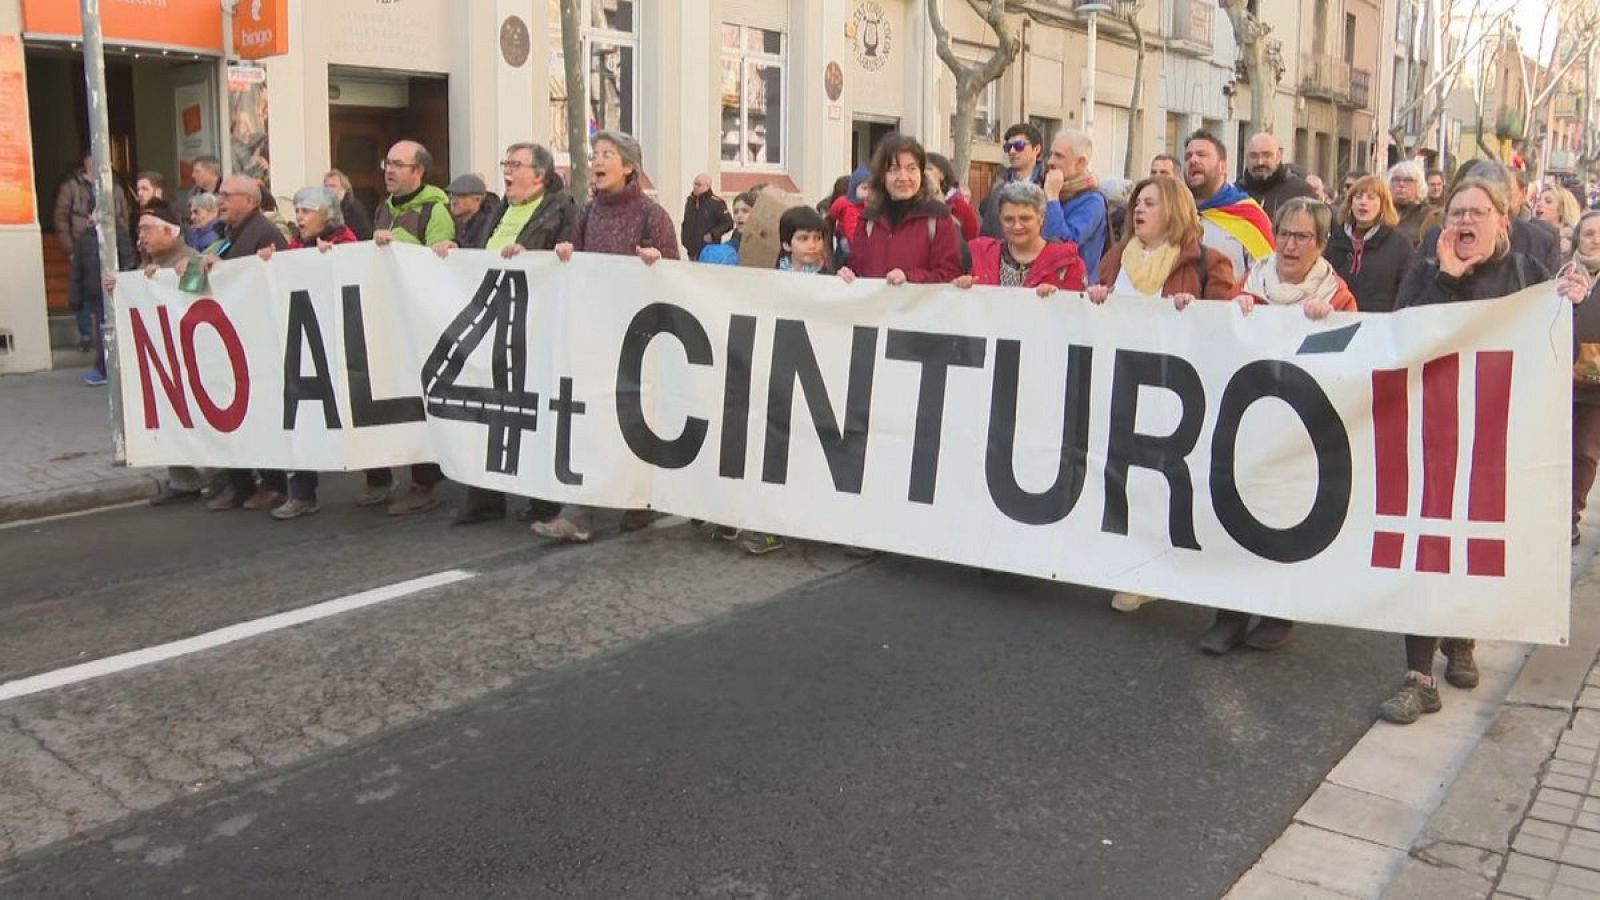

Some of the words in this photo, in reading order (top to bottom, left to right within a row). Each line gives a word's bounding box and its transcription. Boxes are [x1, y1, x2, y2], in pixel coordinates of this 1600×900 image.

[241, 28, 273, 48] bingo
[130, 299, 250, 432] NO
[283, 285, 427, 430] AL
